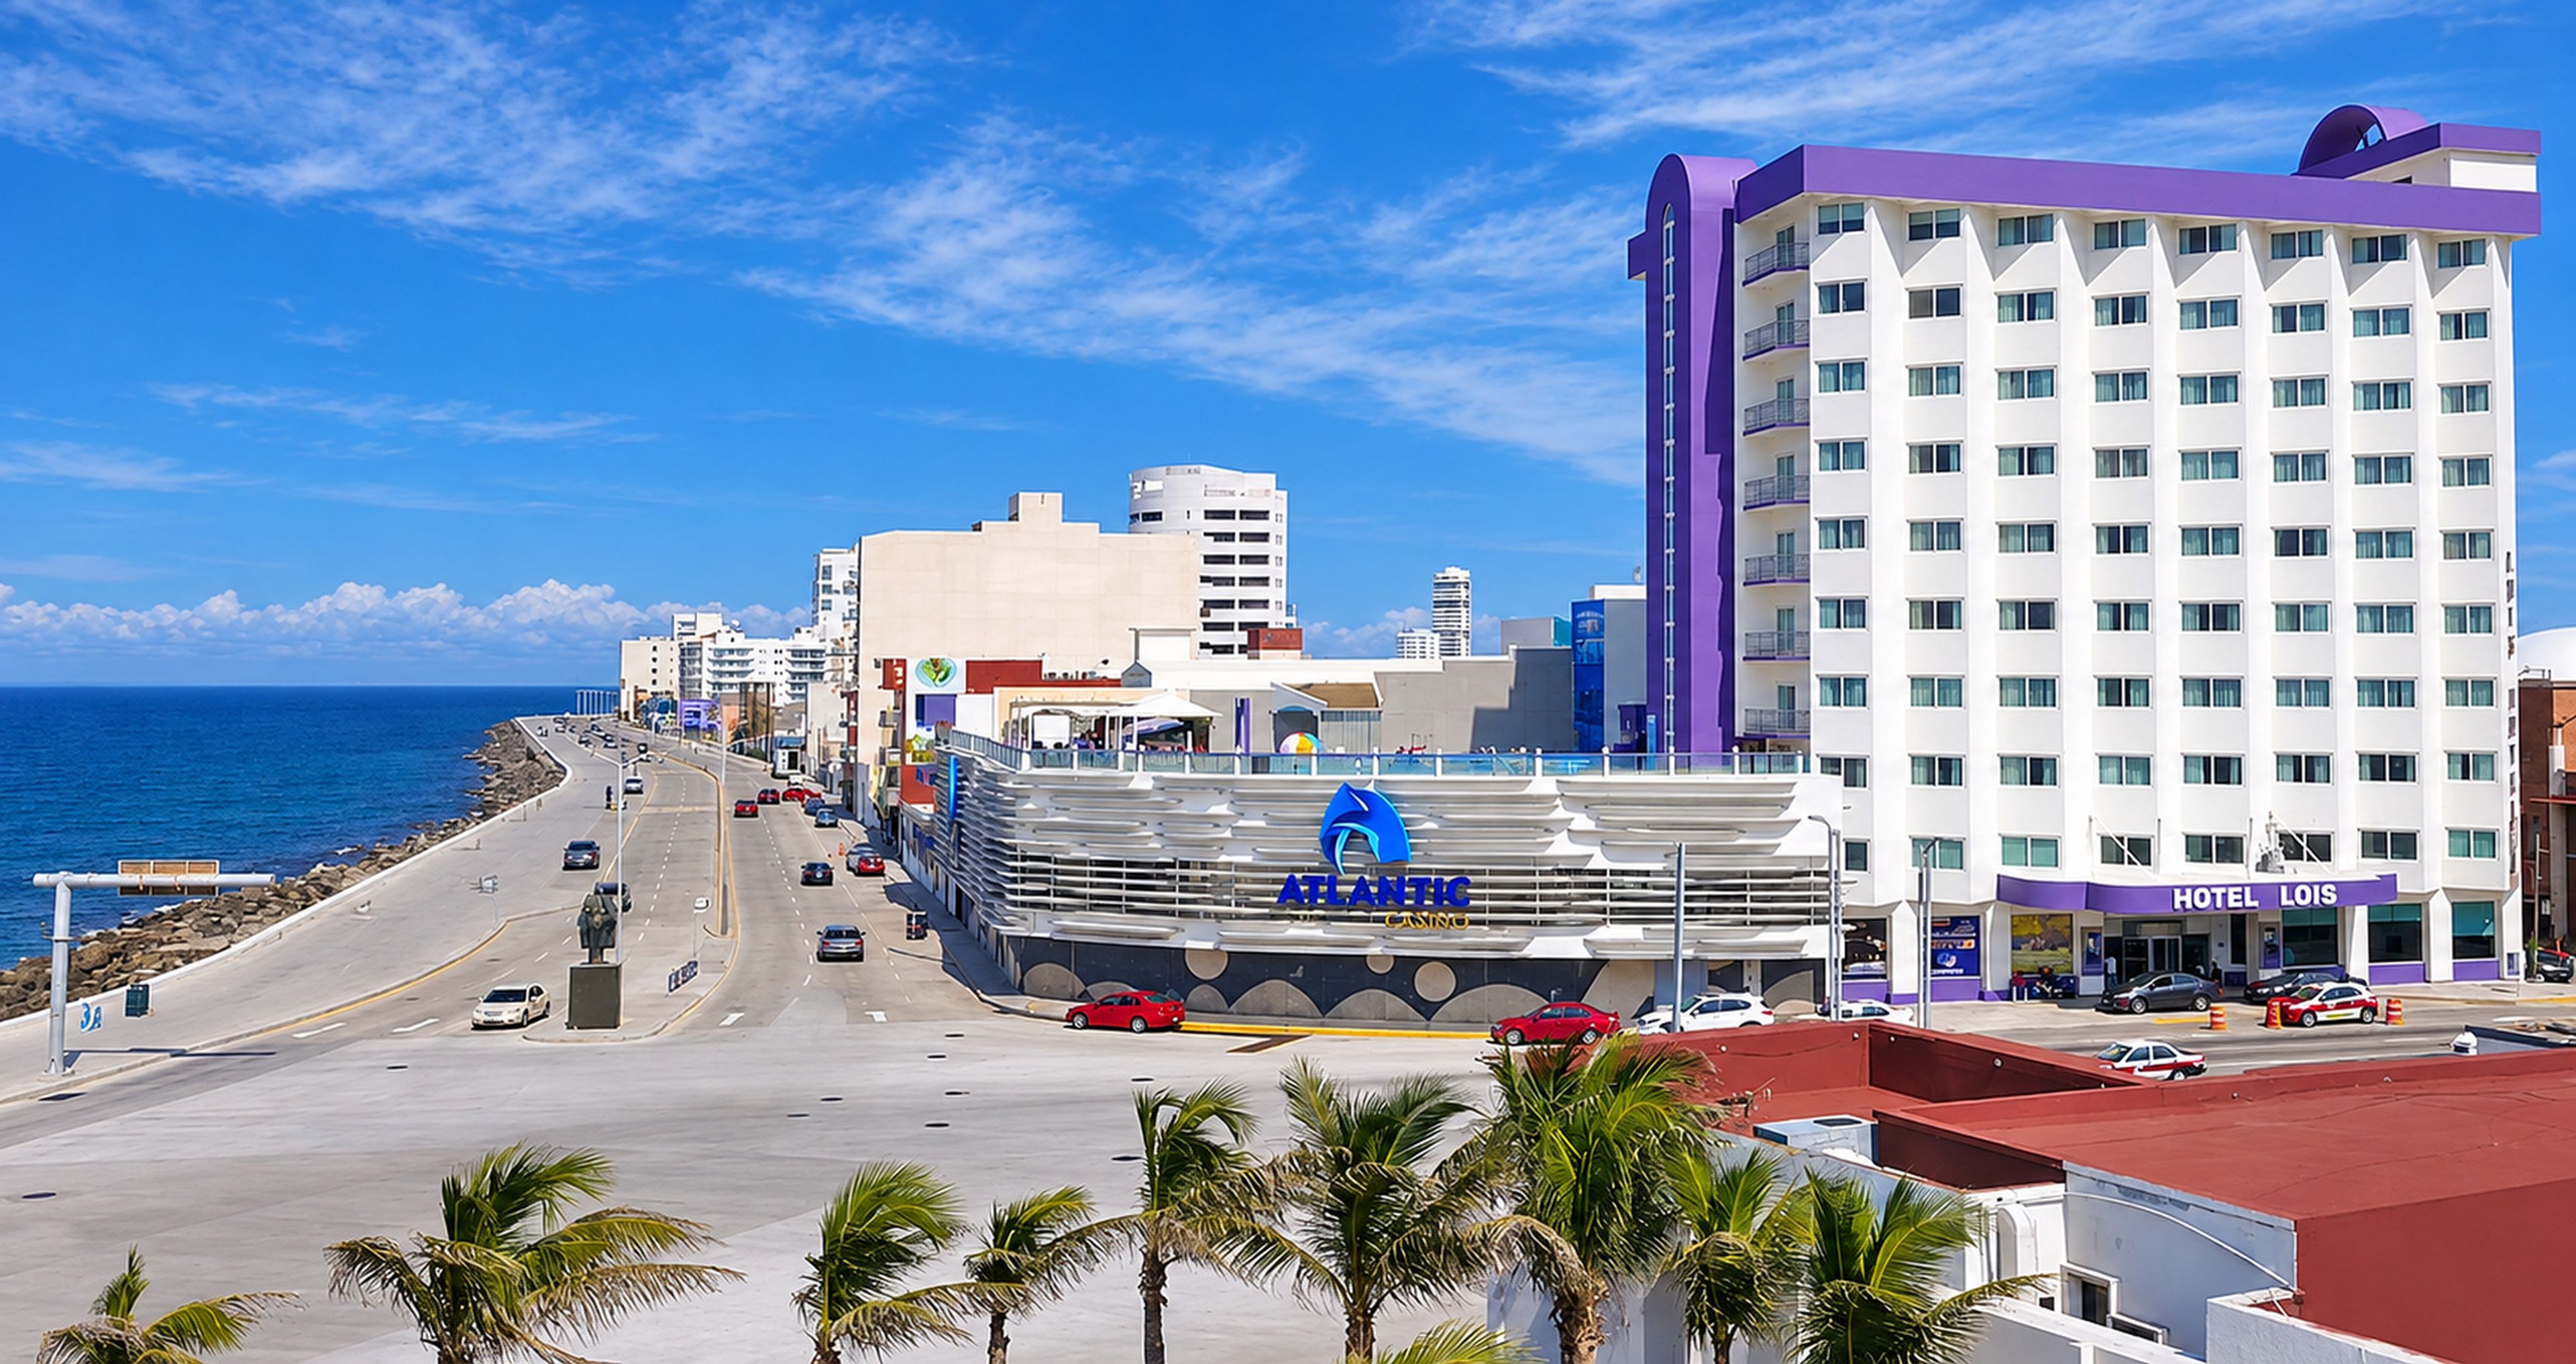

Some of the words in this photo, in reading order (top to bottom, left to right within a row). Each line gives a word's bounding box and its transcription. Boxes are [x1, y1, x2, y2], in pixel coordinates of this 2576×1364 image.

[1277, 873, 1471, 906] ATLANTIC
[2172, 886, 2259, 910] HOTEL
[2279, 883, 2338, 907] LOIS
